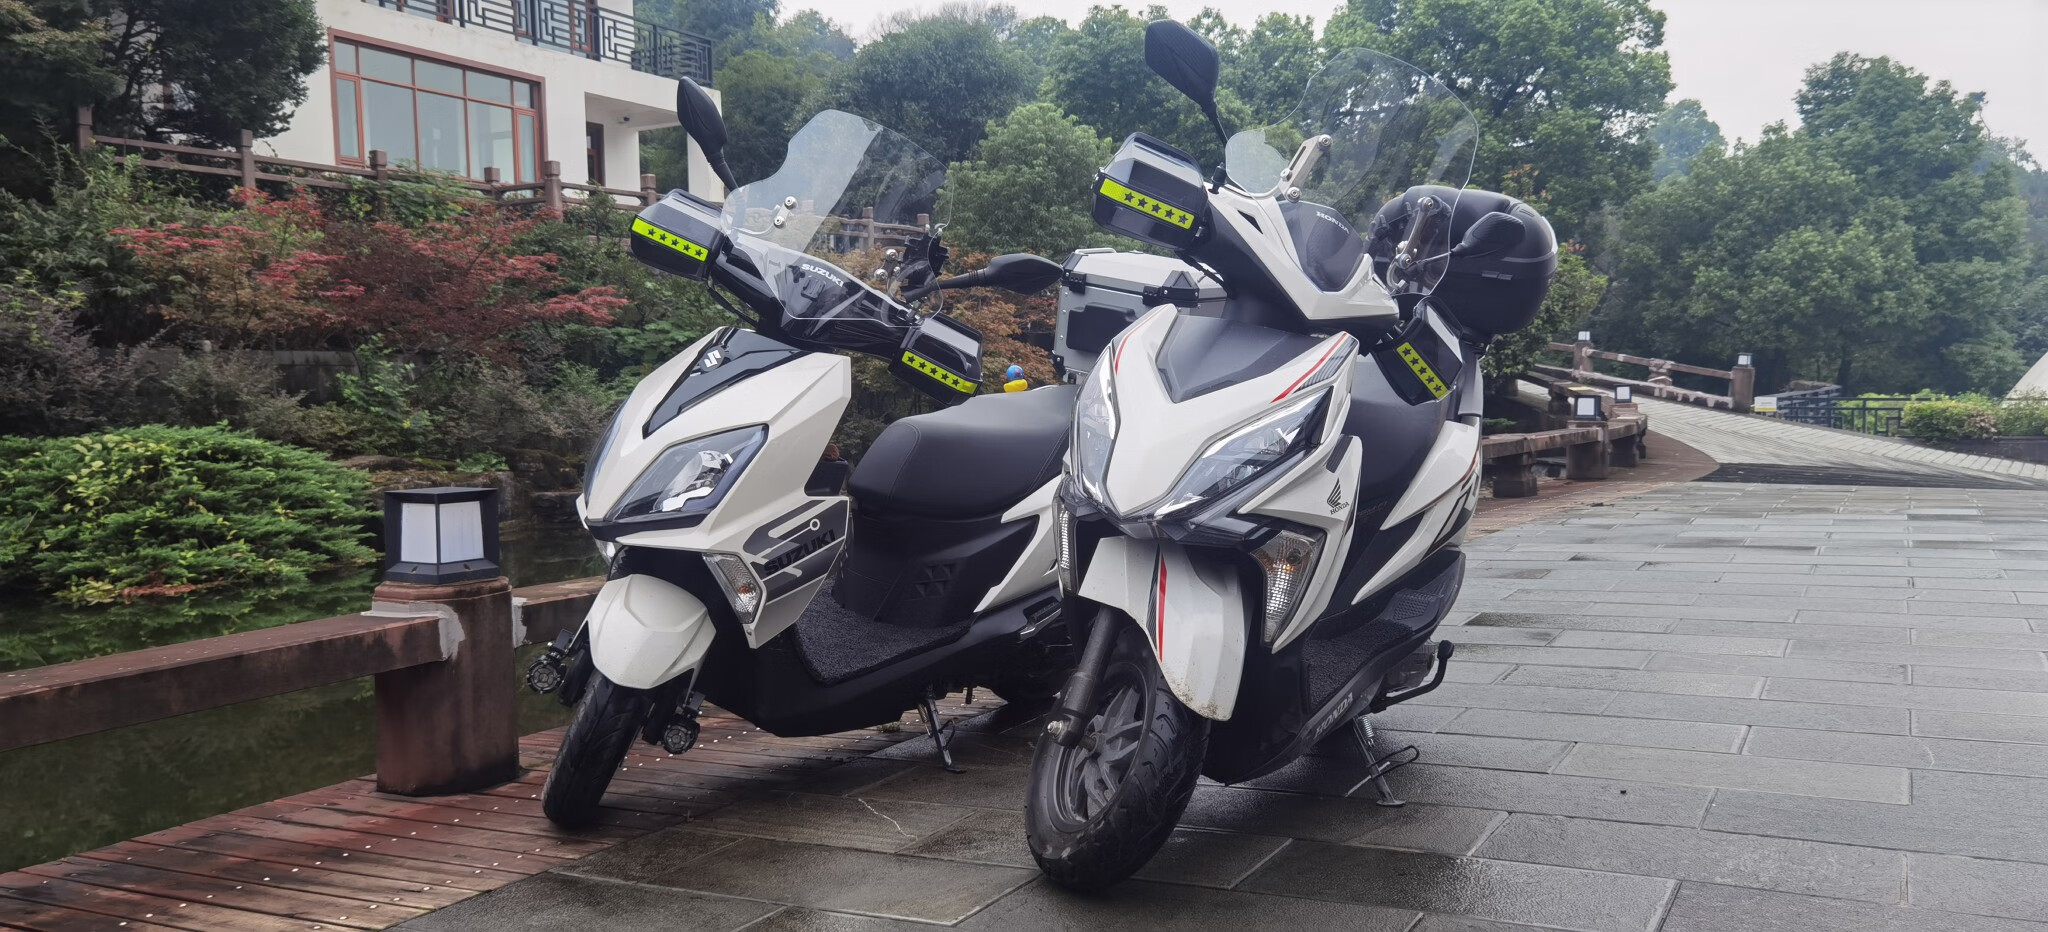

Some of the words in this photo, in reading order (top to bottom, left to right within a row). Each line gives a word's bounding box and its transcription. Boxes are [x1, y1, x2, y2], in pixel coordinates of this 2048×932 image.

[1316, 211, 1350, 234] HONDA
[801, 263, 845, 287] SUZUKI
[1330, 501, 1350, 515] HONDA
[764, 529, 836, 576] SUZUKI
[1313, 692, 1353, 740] HONDA
